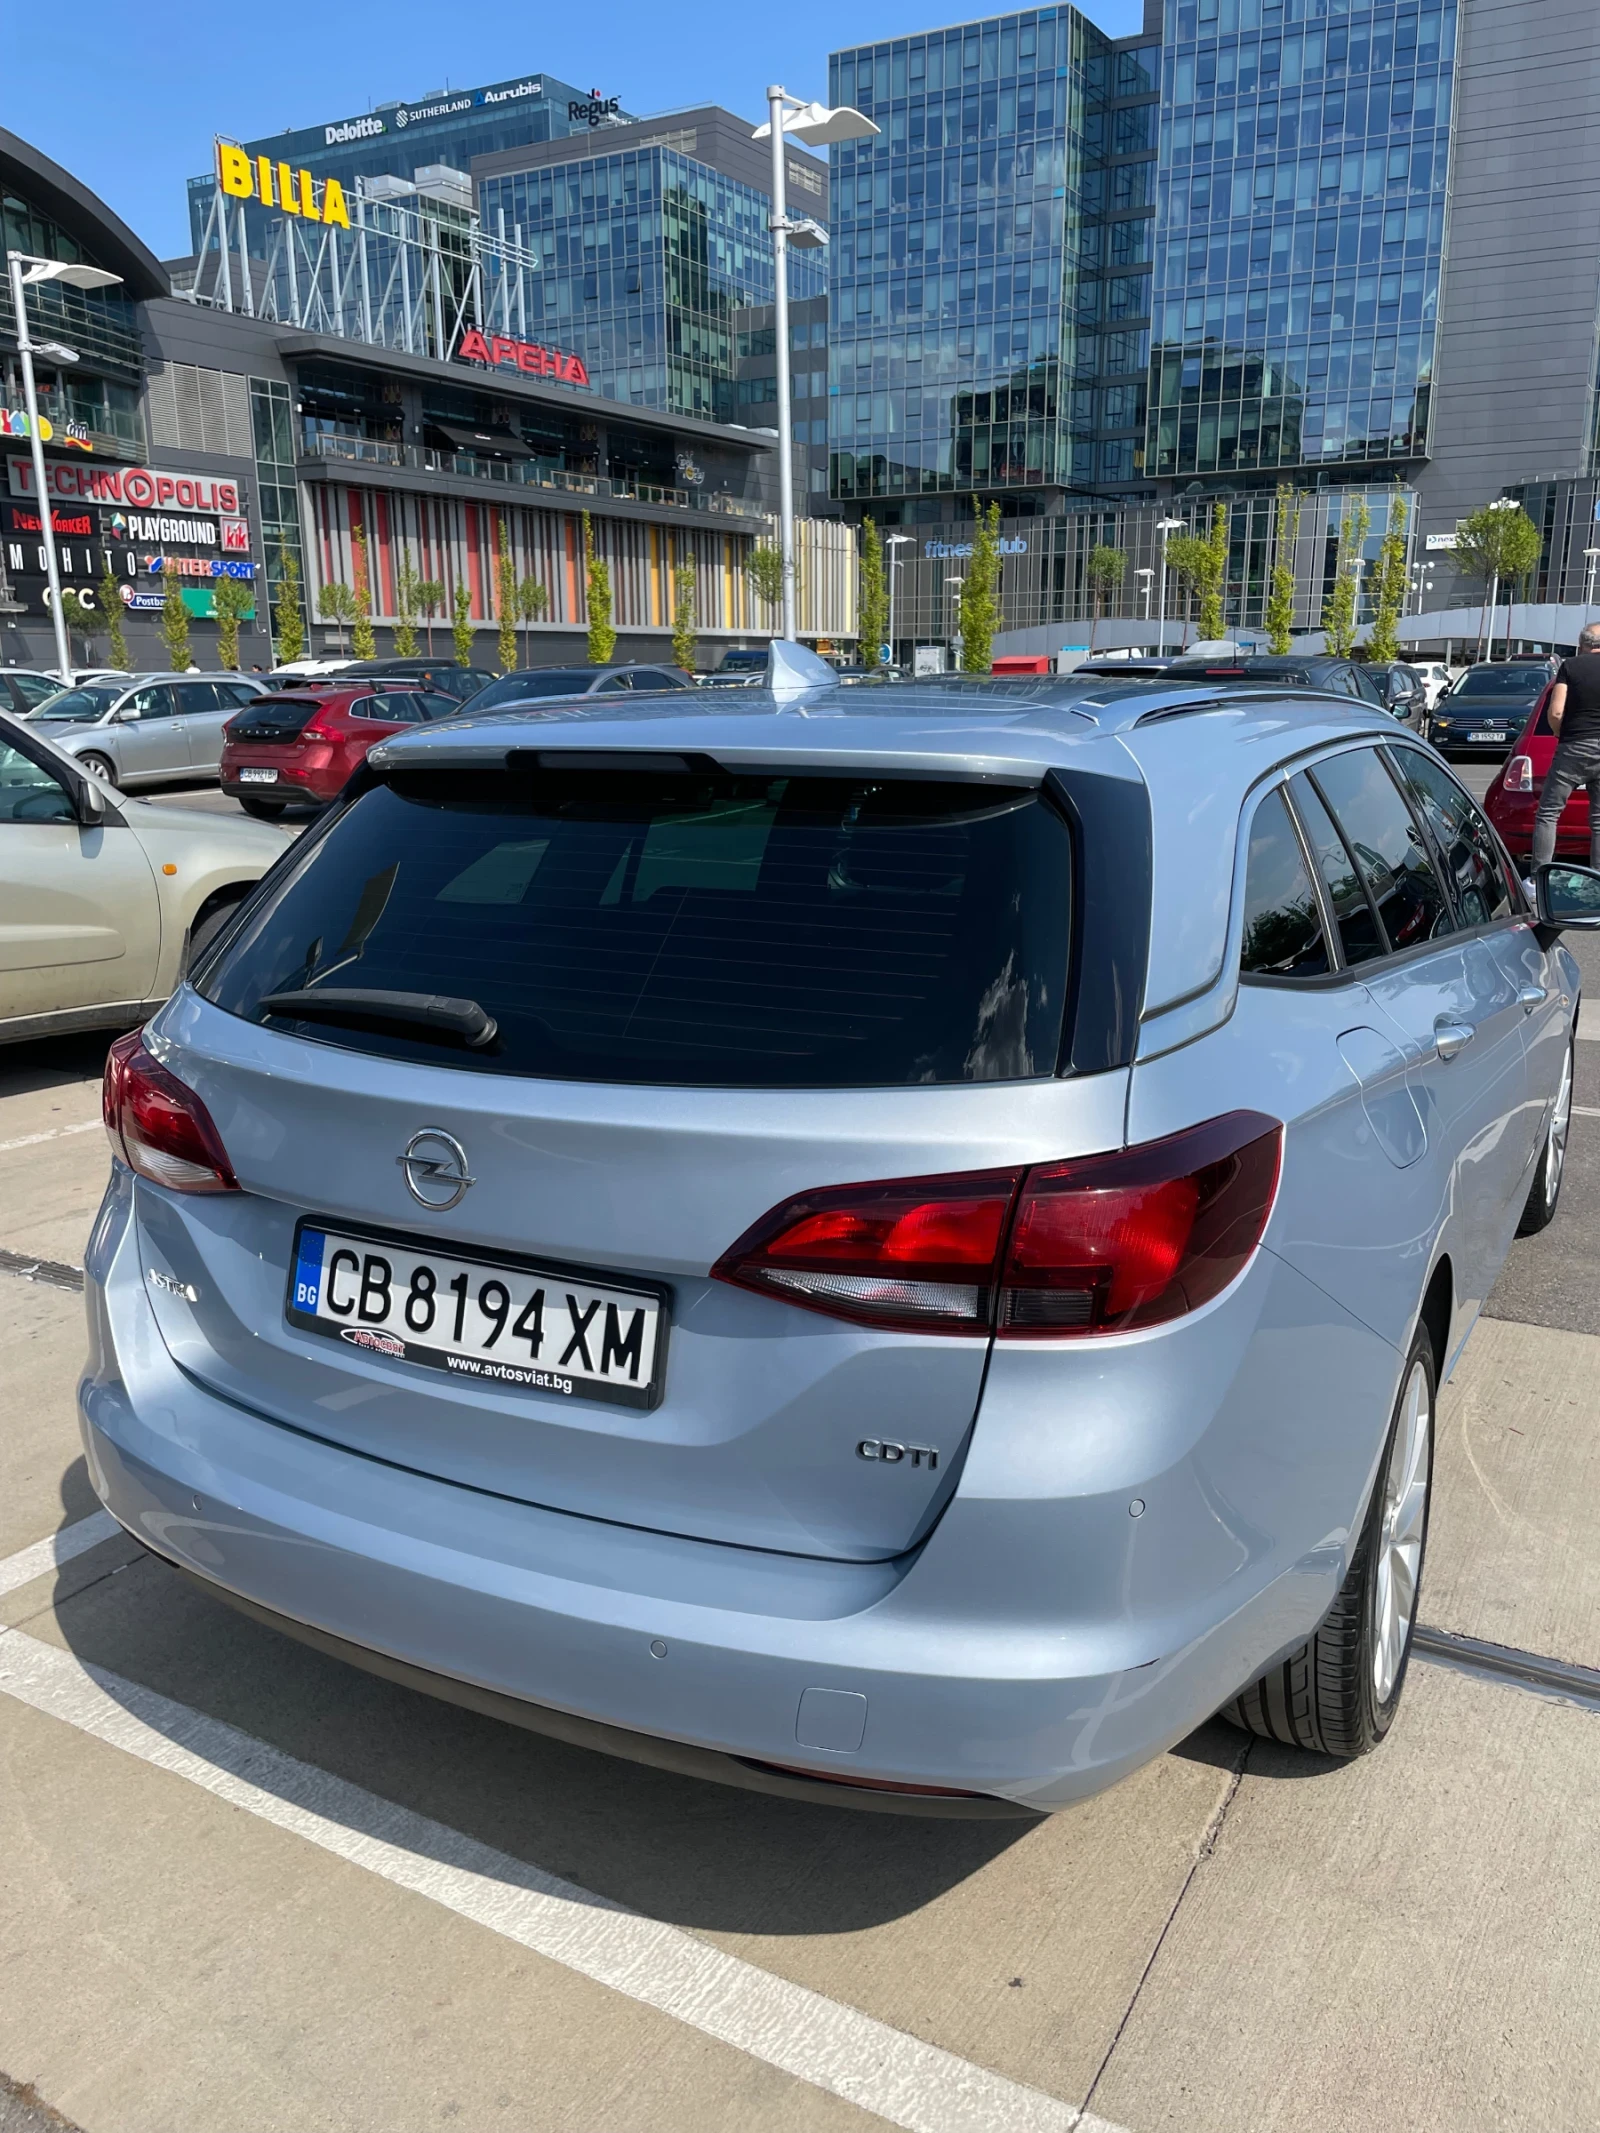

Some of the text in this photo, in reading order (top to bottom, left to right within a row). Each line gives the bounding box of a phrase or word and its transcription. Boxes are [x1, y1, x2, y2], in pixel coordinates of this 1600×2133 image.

[485, 81, 541, 104] Aurubis
[410, 98, 471, 121] SUTHERLAND
[568, 96, 619, 126] Regus
[219, 143, 350, 230] BILLA
[459, 329, 589, 386] АРЕНА
[128, 515, 216, 545] PLAYGROUND
[9, 543, 136, 576] MOHITO
[924, 540, 975, 558] fitnes
[163, 556, 256, 579] INTERSPORT
[136, 596, 167, 607] Postba
[297, 1282, 318, 1306] BG
[327, 1249, 647, 1382] CB 8194 XM
[446, 1355, 573, 1394] www.avtosviat.bg
[857, 1438, 940, 1468] CDTI
